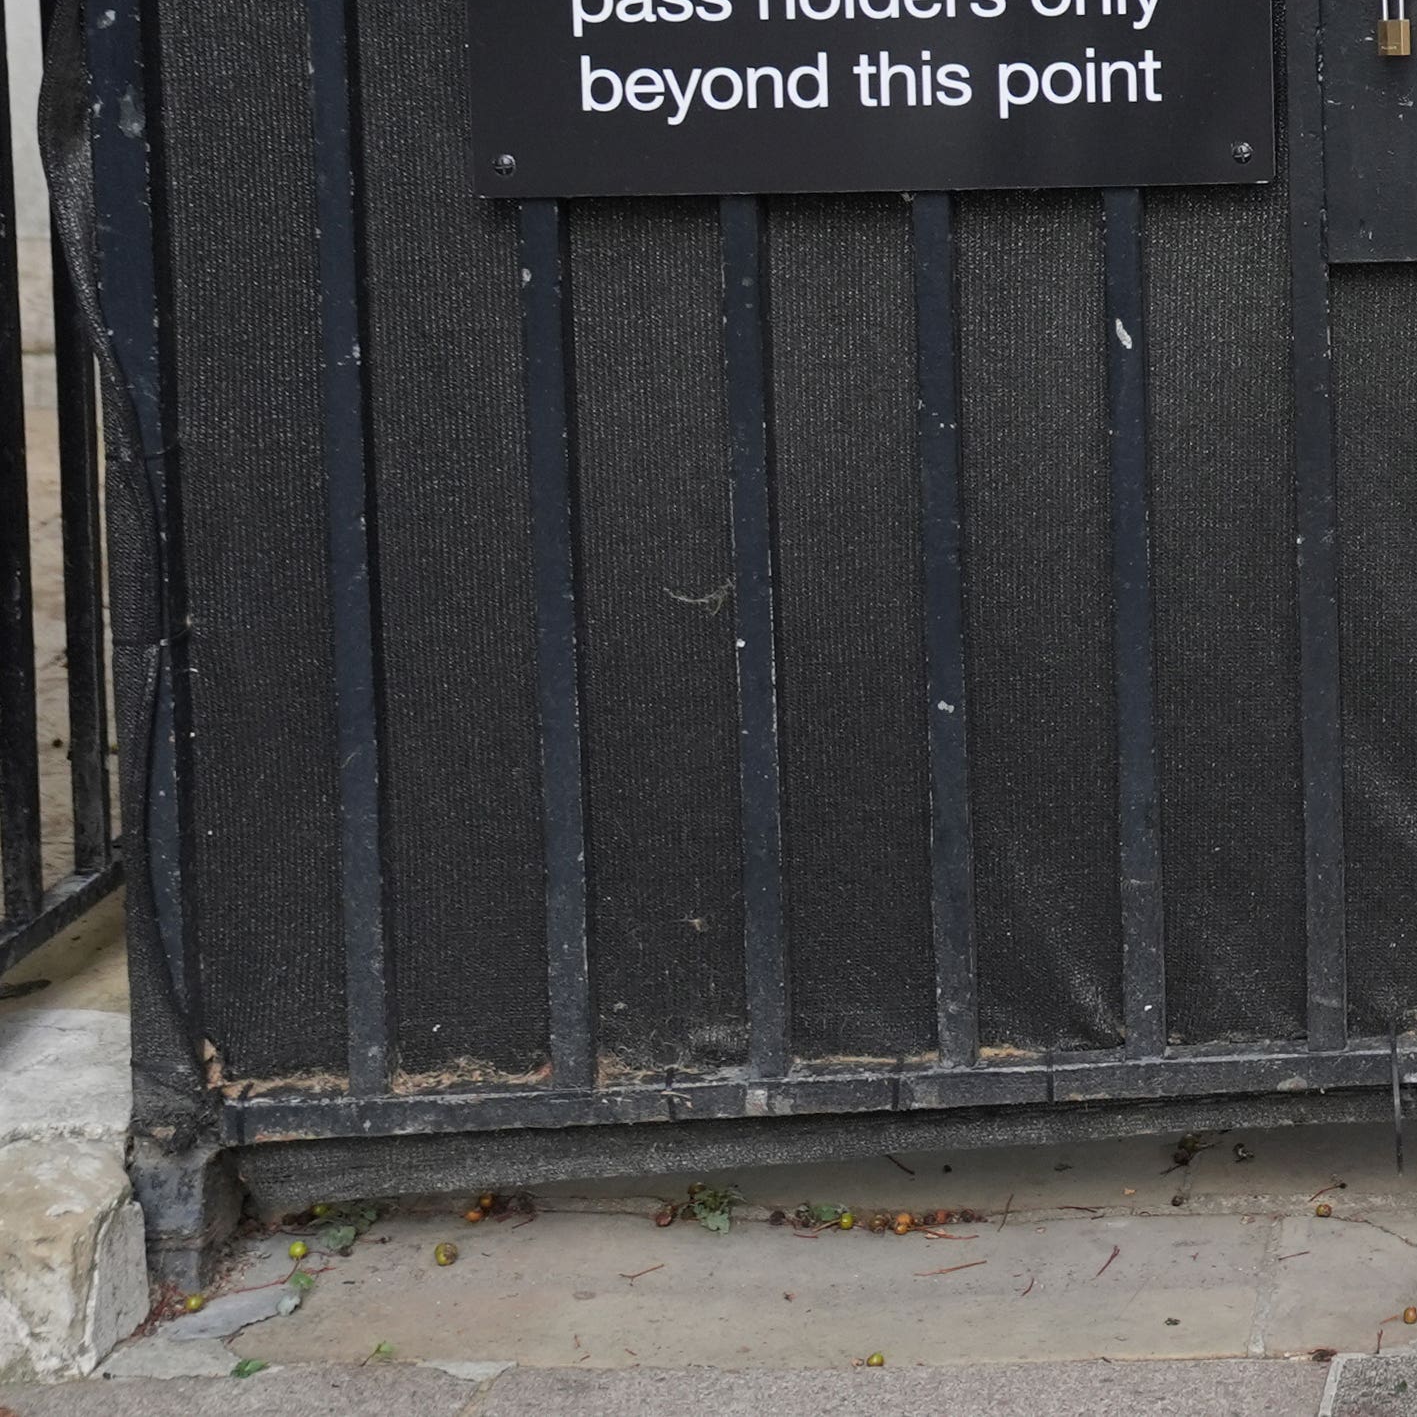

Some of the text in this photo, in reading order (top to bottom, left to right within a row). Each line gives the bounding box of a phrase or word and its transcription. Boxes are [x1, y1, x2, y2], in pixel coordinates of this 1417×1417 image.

[580, 47, 1163, 126] beyond this point
